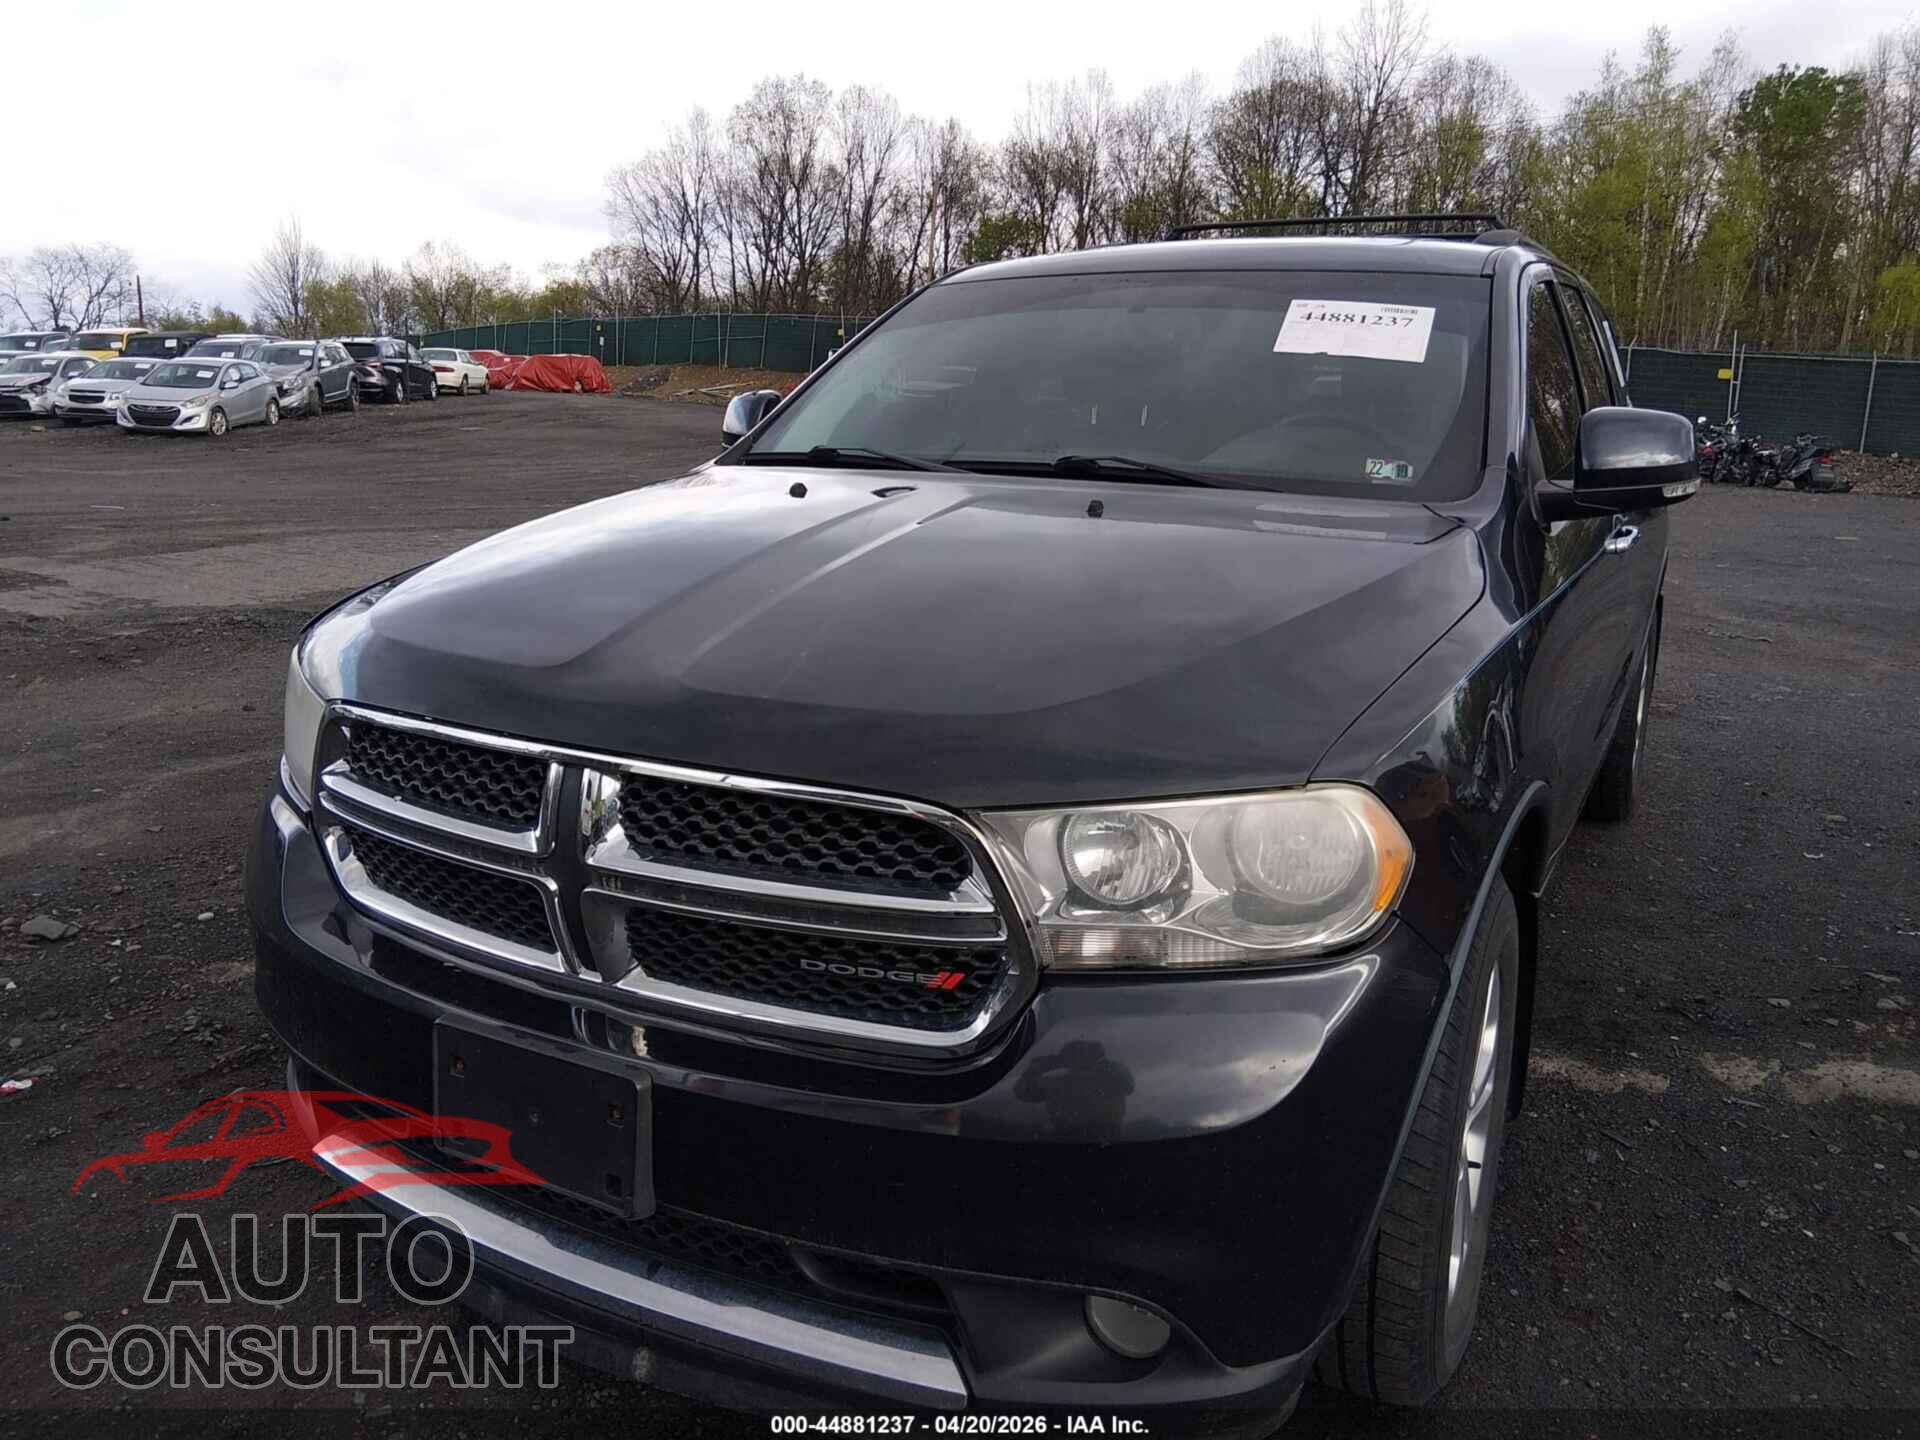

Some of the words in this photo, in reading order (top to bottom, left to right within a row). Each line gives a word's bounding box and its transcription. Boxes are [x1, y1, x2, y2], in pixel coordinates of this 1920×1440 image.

[1300, 311, 1414, 328] 44881237
[1368, 460, 1383, 475] 22
[800, 959, 943, 984] DODGE
